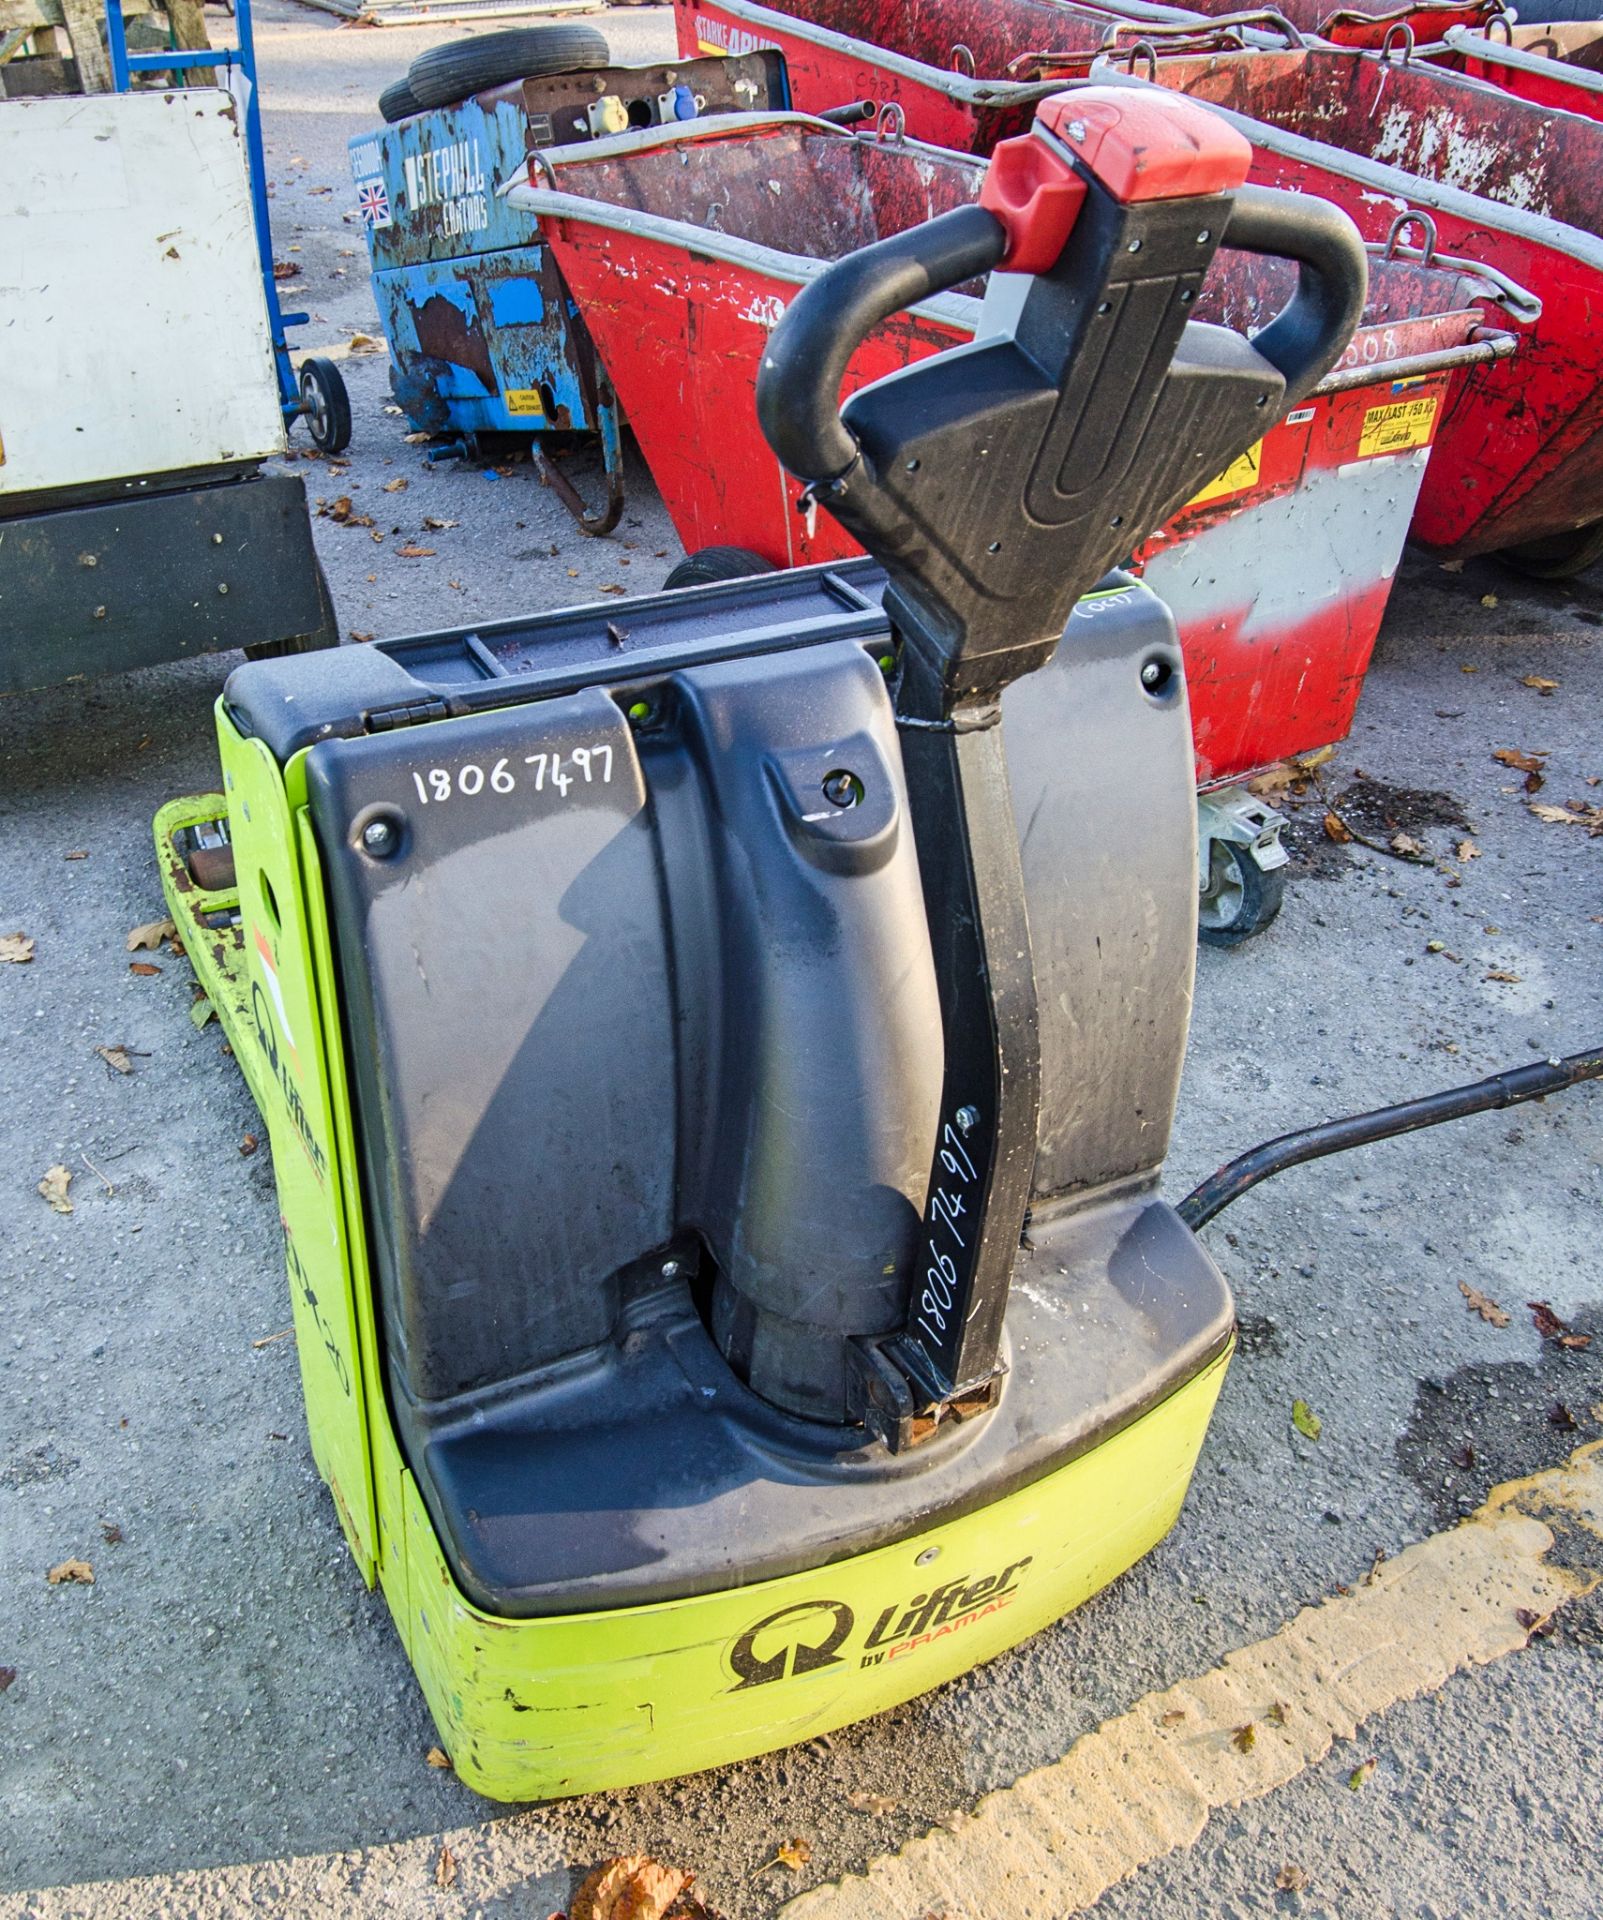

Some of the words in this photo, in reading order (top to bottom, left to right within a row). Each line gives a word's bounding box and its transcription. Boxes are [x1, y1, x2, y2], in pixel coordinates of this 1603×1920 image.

[694, 15, 728, 49] STARKE
[728, 27, 783, 55] ARV
[416, 138, 485, 204] STEPHILL
[864, 1555, 1033, 1649] Lifter
[860, 1651, 885, 1669] by
